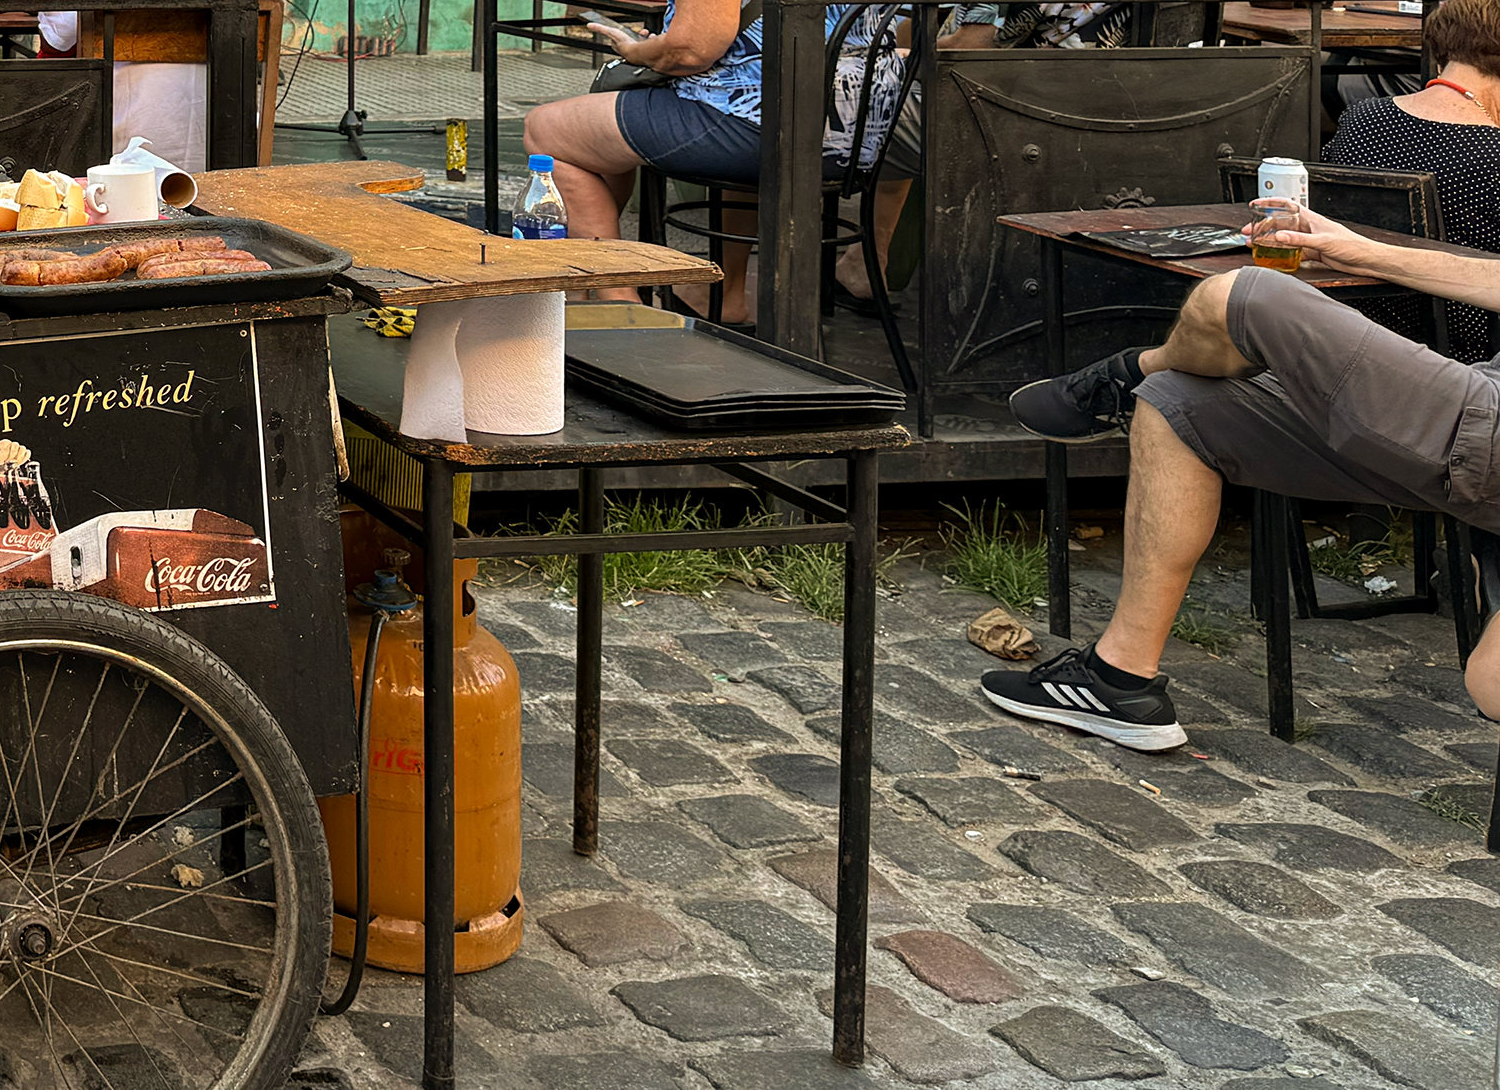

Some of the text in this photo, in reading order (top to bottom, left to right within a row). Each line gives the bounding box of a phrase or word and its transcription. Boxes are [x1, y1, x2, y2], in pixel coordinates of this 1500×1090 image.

[37, 370, 196, 428] refreshed
[2, 528, 56, 550] Coca-Cola
[144, 556, 259, 593] Coca-Cola
